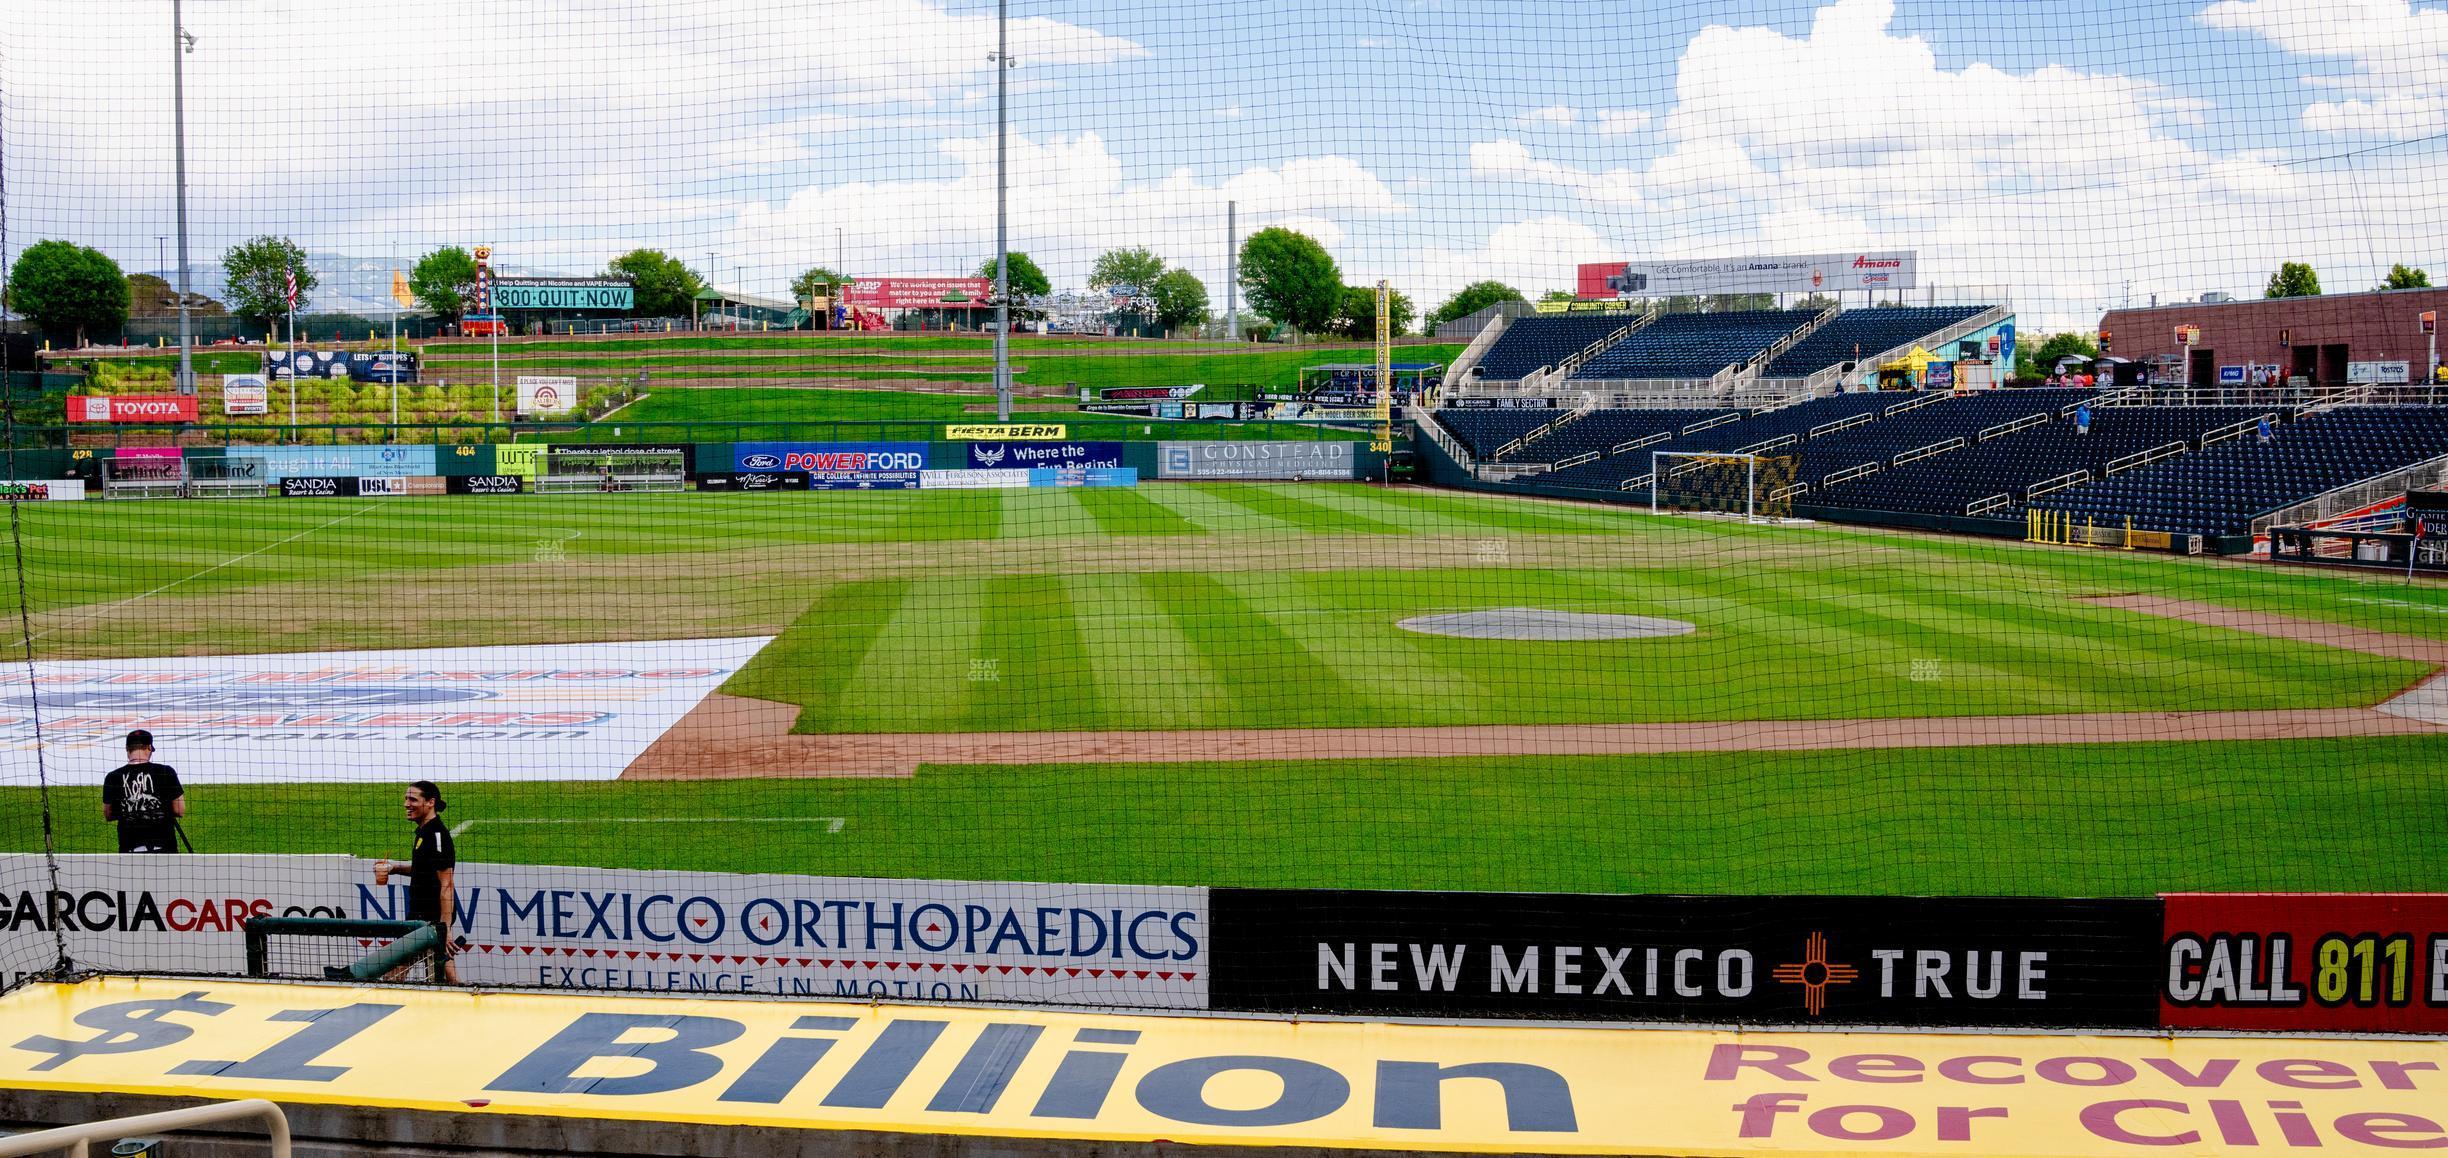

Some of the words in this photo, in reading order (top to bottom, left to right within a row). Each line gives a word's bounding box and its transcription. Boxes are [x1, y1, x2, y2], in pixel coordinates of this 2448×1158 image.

[1852, 255, 1900, 268] Amana
[1656, 266, 1670, 274] Get
[1748, 262, 1778, 270] Amana
[499, 280, 513, 288] Help
[515, 280, 538, 288] Quitting
[548, 280, 573, 288] Nicotine
[574, 280, 585, 288] and
[586, 280, 602, 288] VAPE
[603, 280, 630, 288] Products
[962, 289, 982, 298] family
[896, 297, 911, 305] right
[1571, 301, 1604, 310] COMMUNITY
[1605, 301, 1627, 309] CORNER
[353, 353, 368, 361] LETS
[378, 353, 408, 361] ISOTPES
[114, 402, 180, 415] TOYOTA
[1496, 398, 1520, 408] FAMILY
[1521, 398, 1548, 408] SECTION
[1314, 410, 1322, 418] THE
[1323, 410, 1342, 418] MODEL
[1343, 410, 1356, 418] BEER
[1357, 410, 1371, 418] SINCE
[952, 426, 1006, 434] FIESTA
[1008, 426, 1060, 437] BERM
[456, 446, 475, 456] 404
[1013, 447, 1058, 460] Where
[1061, 445, 1085, 457] the
[1204, 444, 1343, 459] GONSTEAD
[1370, 442, 1388, 452] 340
[314, 457, 324, 470] It
[749, 456, 774, 467] Ford
[785, 452, 922, 470] POWERFORD
[1066, 458, 1118, 468] Begins!
[878, 471, 917, 479] POSSIBILITIES
[921, 471, 945, 480] WILL
[986, 470, 1028, 479] ASSOCIATES
[285, 478, 337, 490] SANDIA
[467, 476, 518, 487] SANDIA
[29, 483, 48, 493] Pet
[226, 667, 732, 685] MEXICO
[38, 710, 614, 732] DEALERS
[356, 883, 481, 935] NW
[496, 887, 726, 944] MEXICO
[740, 898, 1200, 962] ORTHOPAEDICS
[1317, 941, 1466, 994] NEW
[1490, 944, 1754, 999] MEXICO
[1872, 949, 2049, 1001] TRUE
[2167, 936, 2305, 1004] CALL
[2318, 938, 2410, 1003] 811
[540, 964, 754, 993] EXCELLENCE
[777, 975, 810, 997] IN
[834, 978, 981, 1000] MOTION
[12, 990, 405, 1082] $1
[481, 1010, 1579, 1134] Billion
[1703, 1042, 2441, 1091] Recover
[1732, 1091, 2010, 1144] for
